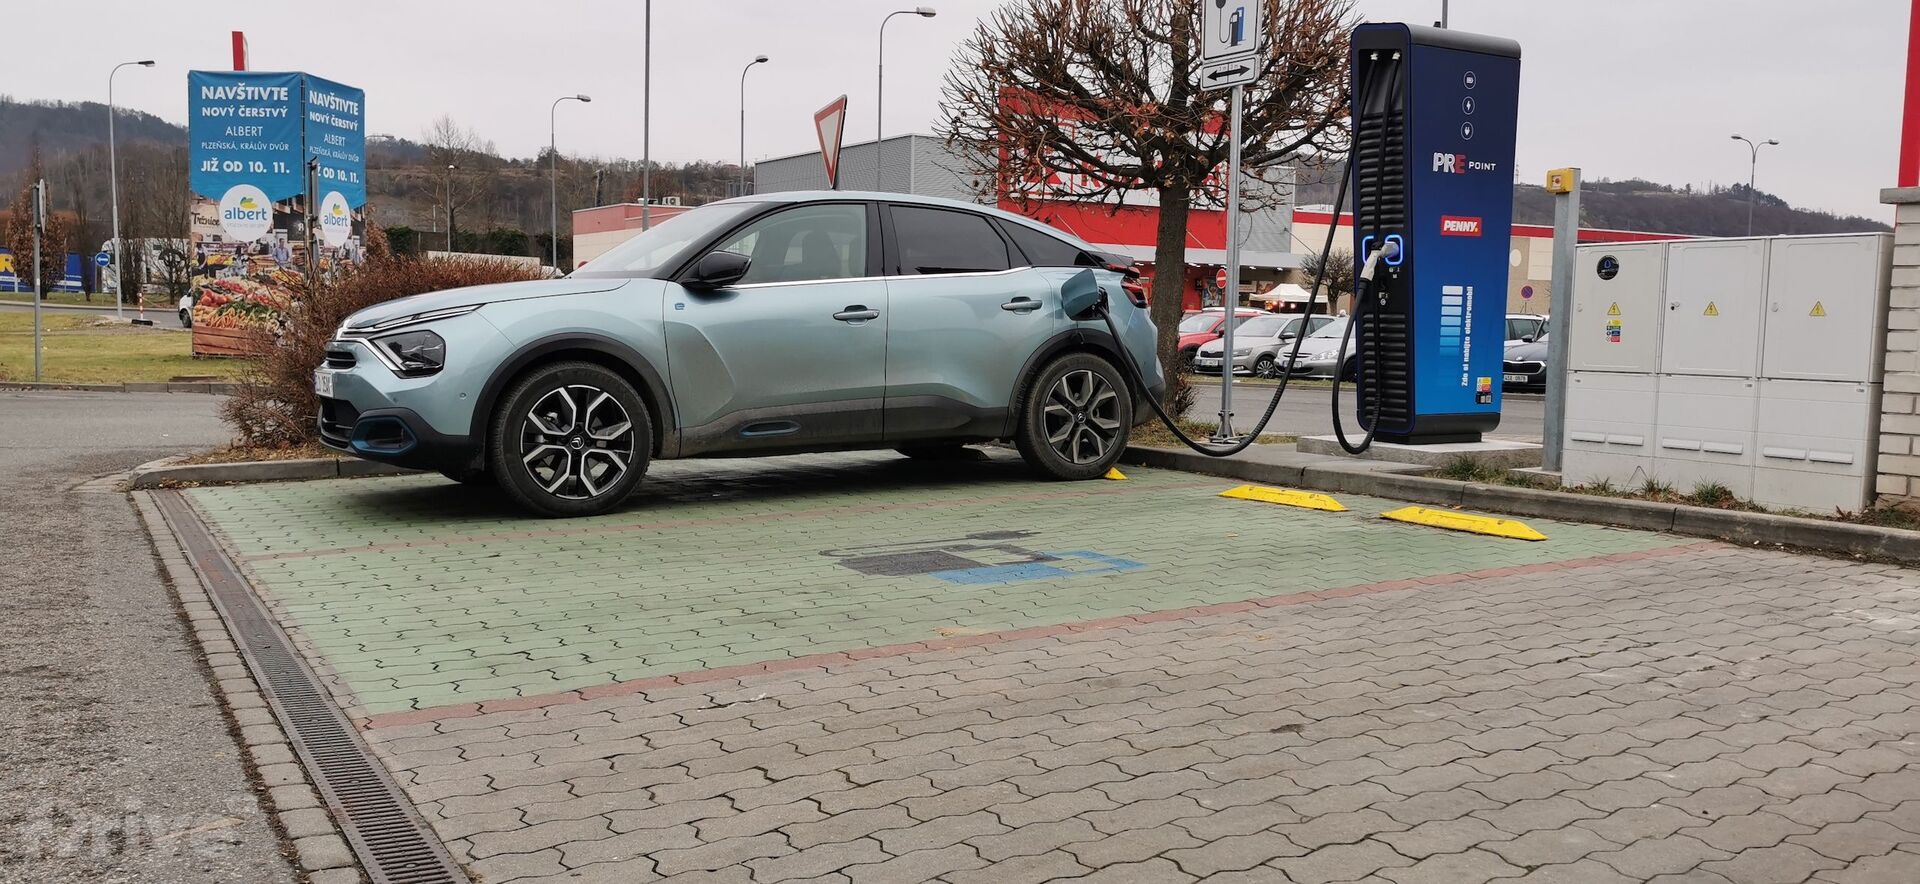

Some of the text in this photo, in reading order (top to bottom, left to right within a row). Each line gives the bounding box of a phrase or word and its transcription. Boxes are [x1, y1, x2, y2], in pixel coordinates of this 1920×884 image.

[201, 83, 289, 101] NAVŠTIVTE
[202, 105, 288, 117] NOVÝ ČERSTVÝ
[309, 90, 359, 116] NAVŠTIVTE
[309, 111, 358, 131] NOVÝ ČERSTVÝ
[225, 126, 263, 136] ALBERT
[201, 141, 289, 151] PLZEŇSKÁ, KRÁLŮV DVŮR
[324, 133, 346, 147] ALBERT
[200, 157, 290, 173] JIŽ OD 10. 11.
[1432, 152, 1497, 174] PRE POINT
[323, 166, 335, 179] OD
[337, 169, 347, 182] 10.
[350, 171, 359, 184] 11.
[224, 207, 268, 221] albert
[323, 212, 349, 228] albert
[1464, 286, 1473, 334] elektromobil
